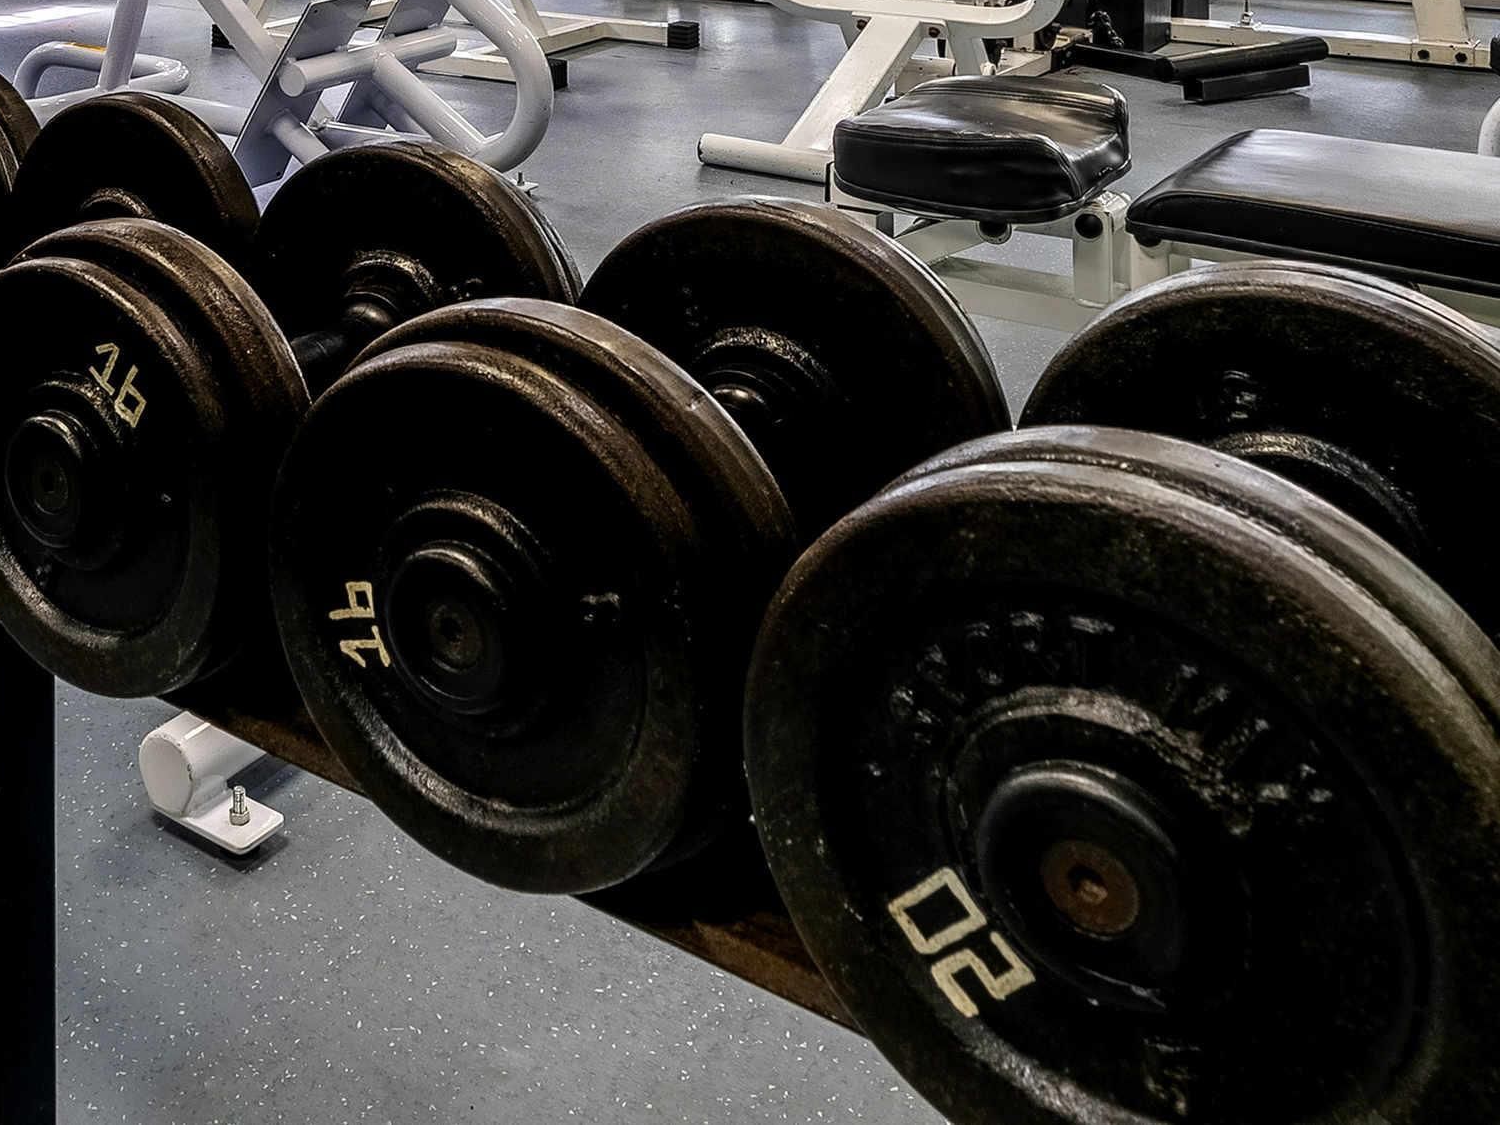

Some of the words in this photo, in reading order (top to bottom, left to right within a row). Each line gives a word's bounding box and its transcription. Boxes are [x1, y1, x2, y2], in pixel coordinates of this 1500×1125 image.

[88, 342, 147, 428] 16
[328, 581, 391, 667] 16
[887, 866, 1036, 1018] 20
